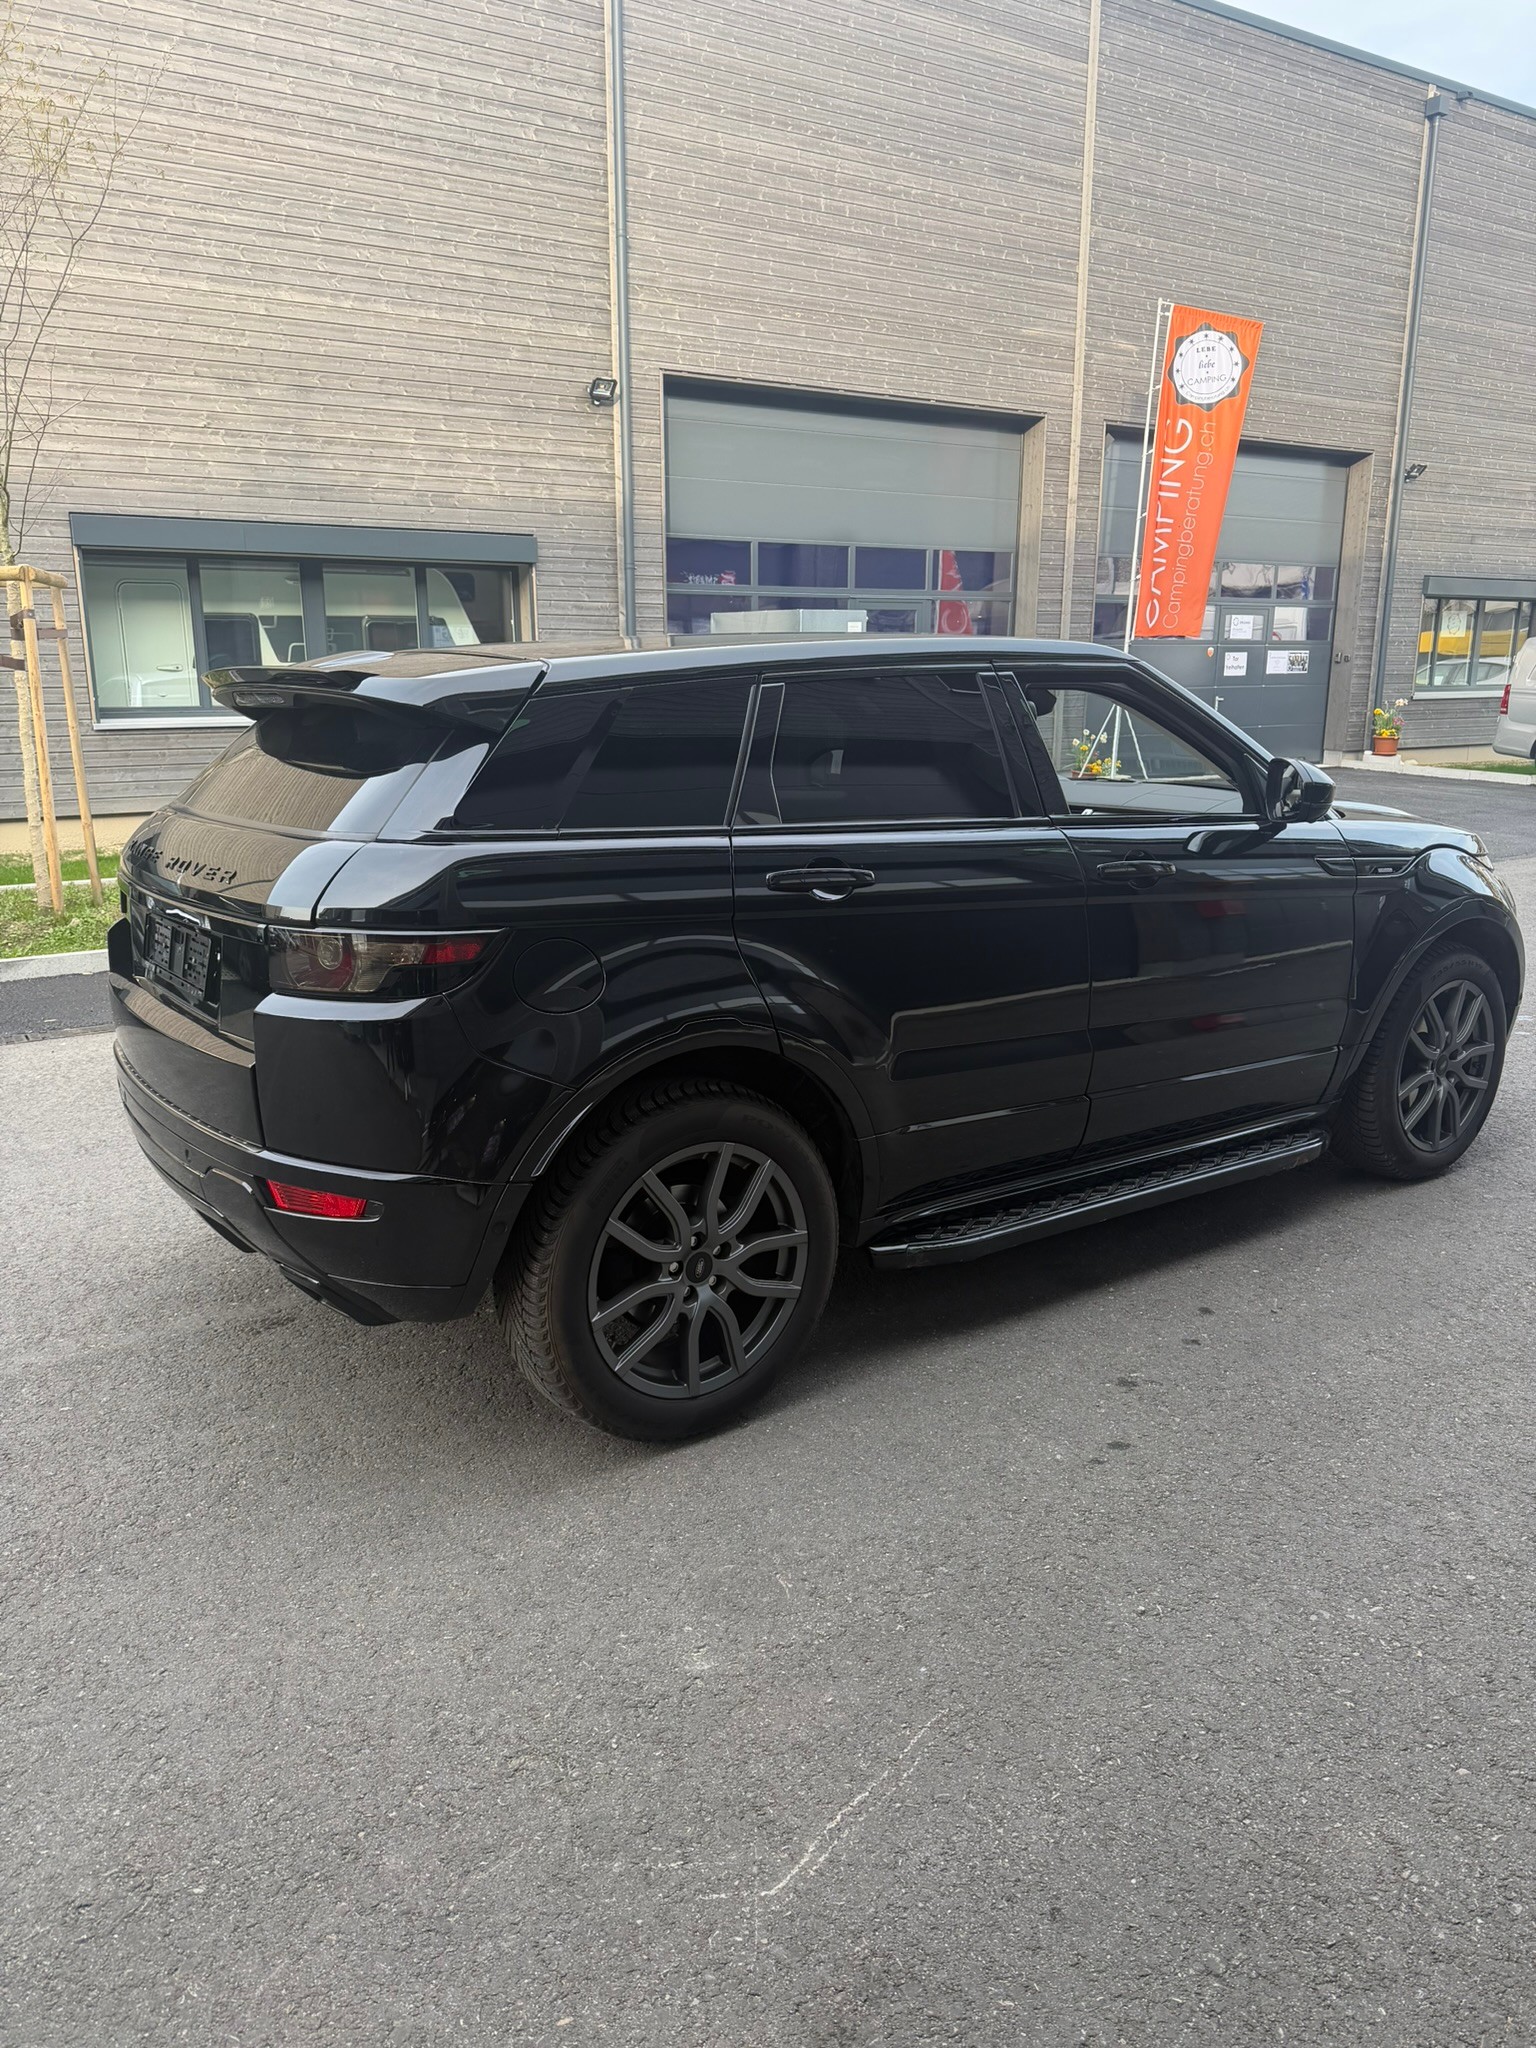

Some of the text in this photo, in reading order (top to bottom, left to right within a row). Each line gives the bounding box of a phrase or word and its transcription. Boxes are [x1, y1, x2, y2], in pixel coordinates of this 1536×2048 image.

[1196, 345, 1217, 353] LEBE
[1198, 358, 1216, 369] liebe
[1187, 373, 1227, 386] CAMPING
[1162, 421, 1217, 629] Campingberatung.ch
[165, 857, 238, 885] ROVER
